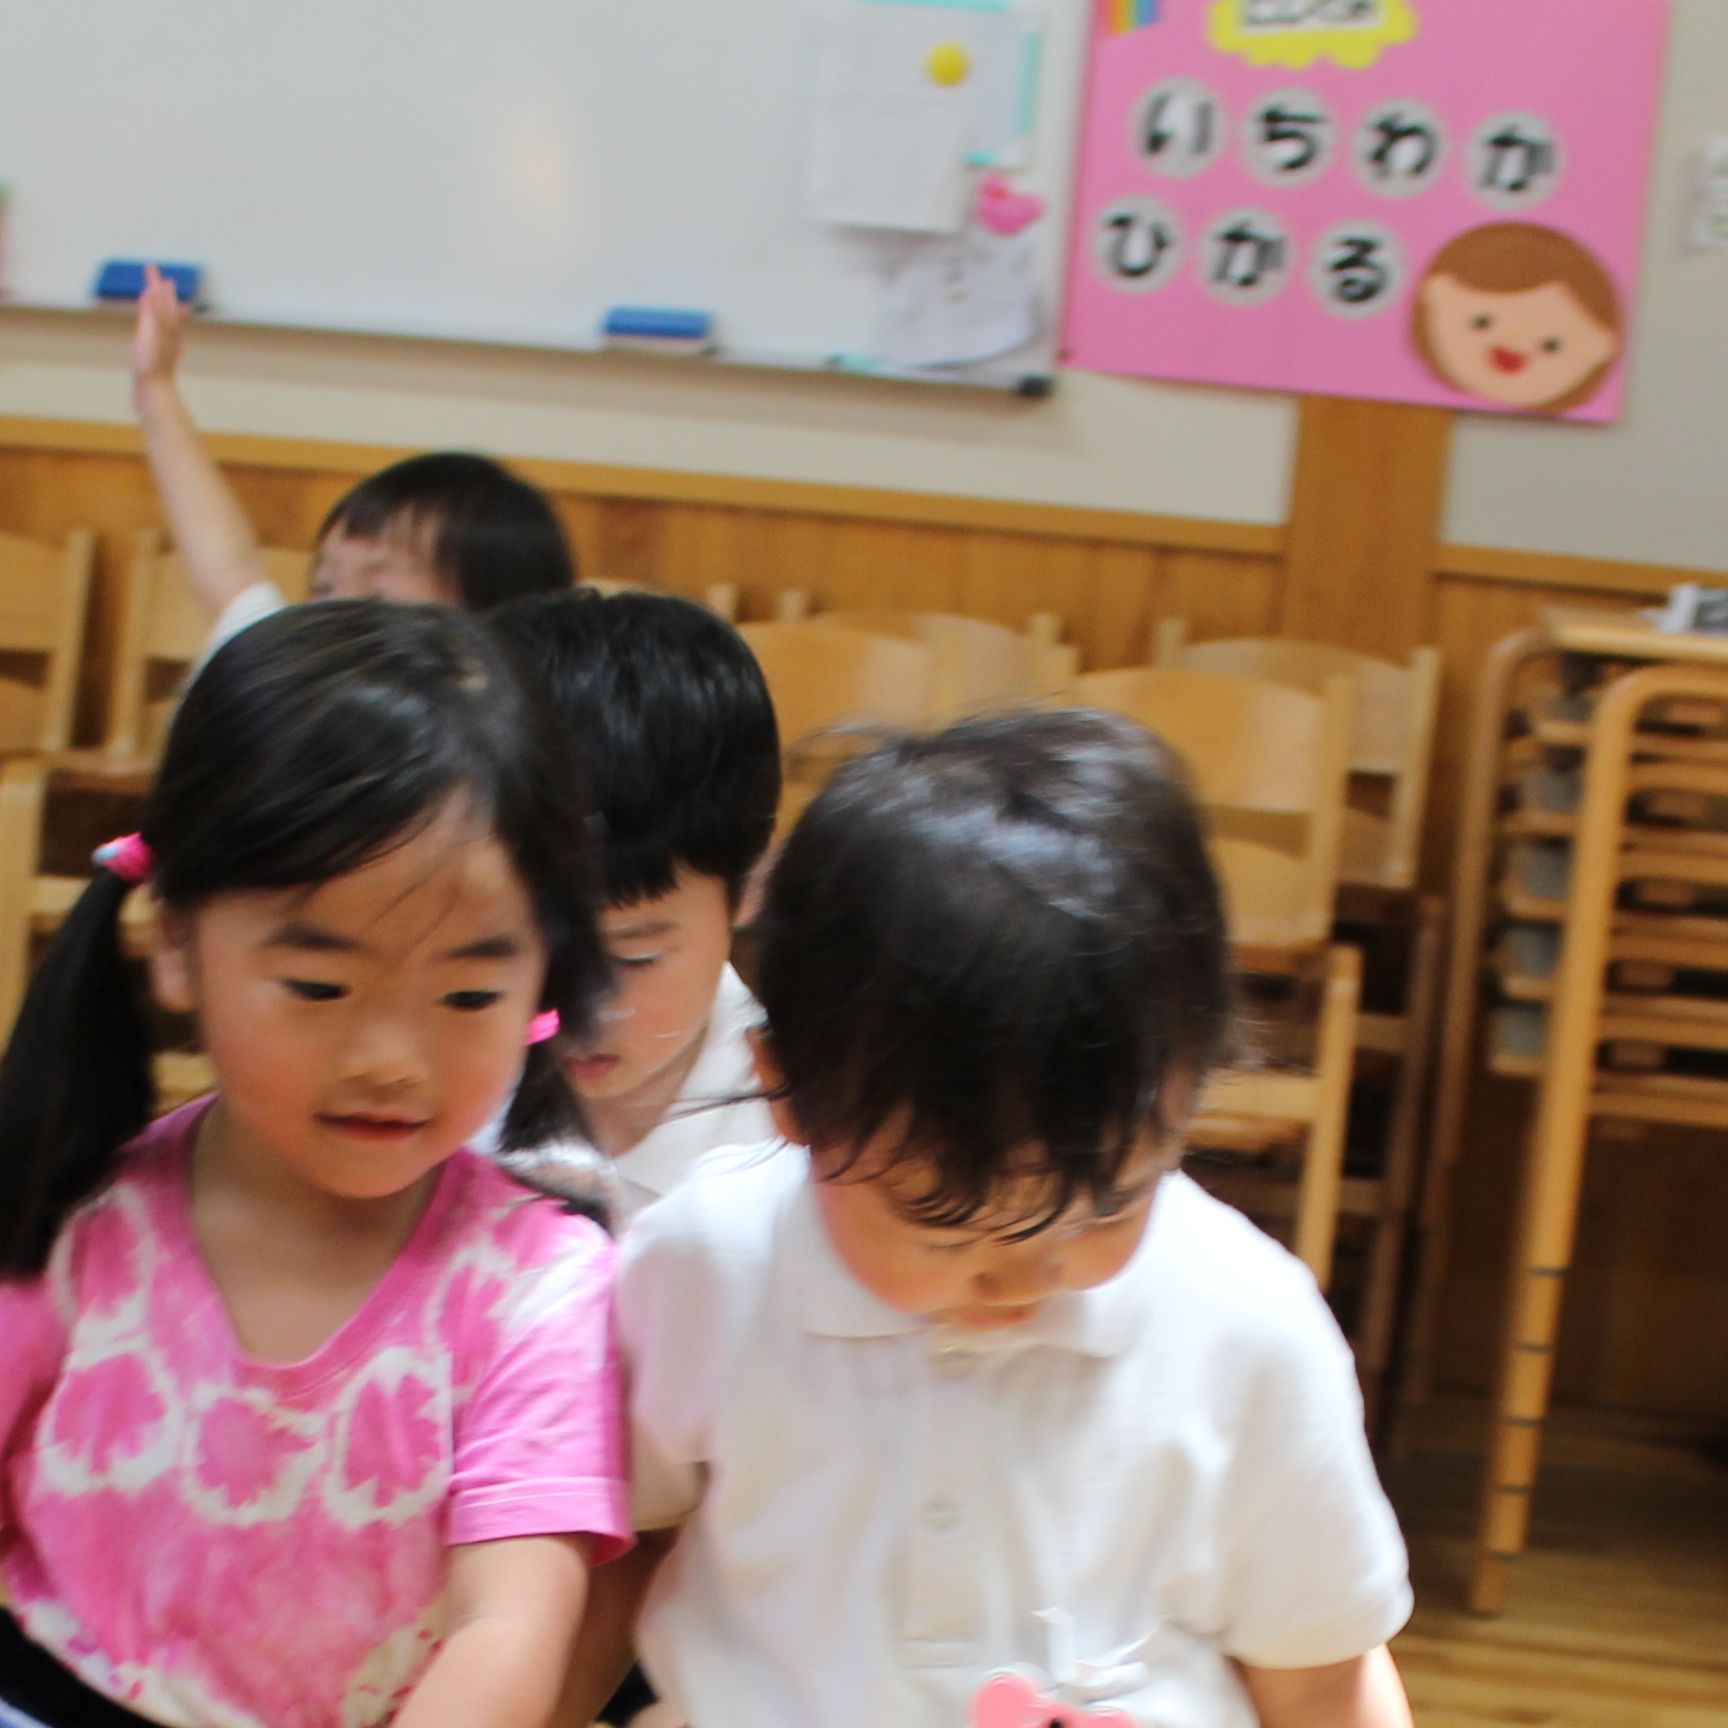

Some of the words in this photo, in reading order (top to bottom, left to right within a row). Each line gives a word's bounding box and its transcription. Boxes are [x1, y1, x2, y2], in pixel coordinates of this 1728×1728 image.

[1138, 88, 1556, 194] いちわか
[1101, 210, 1388, 303] ひかる
